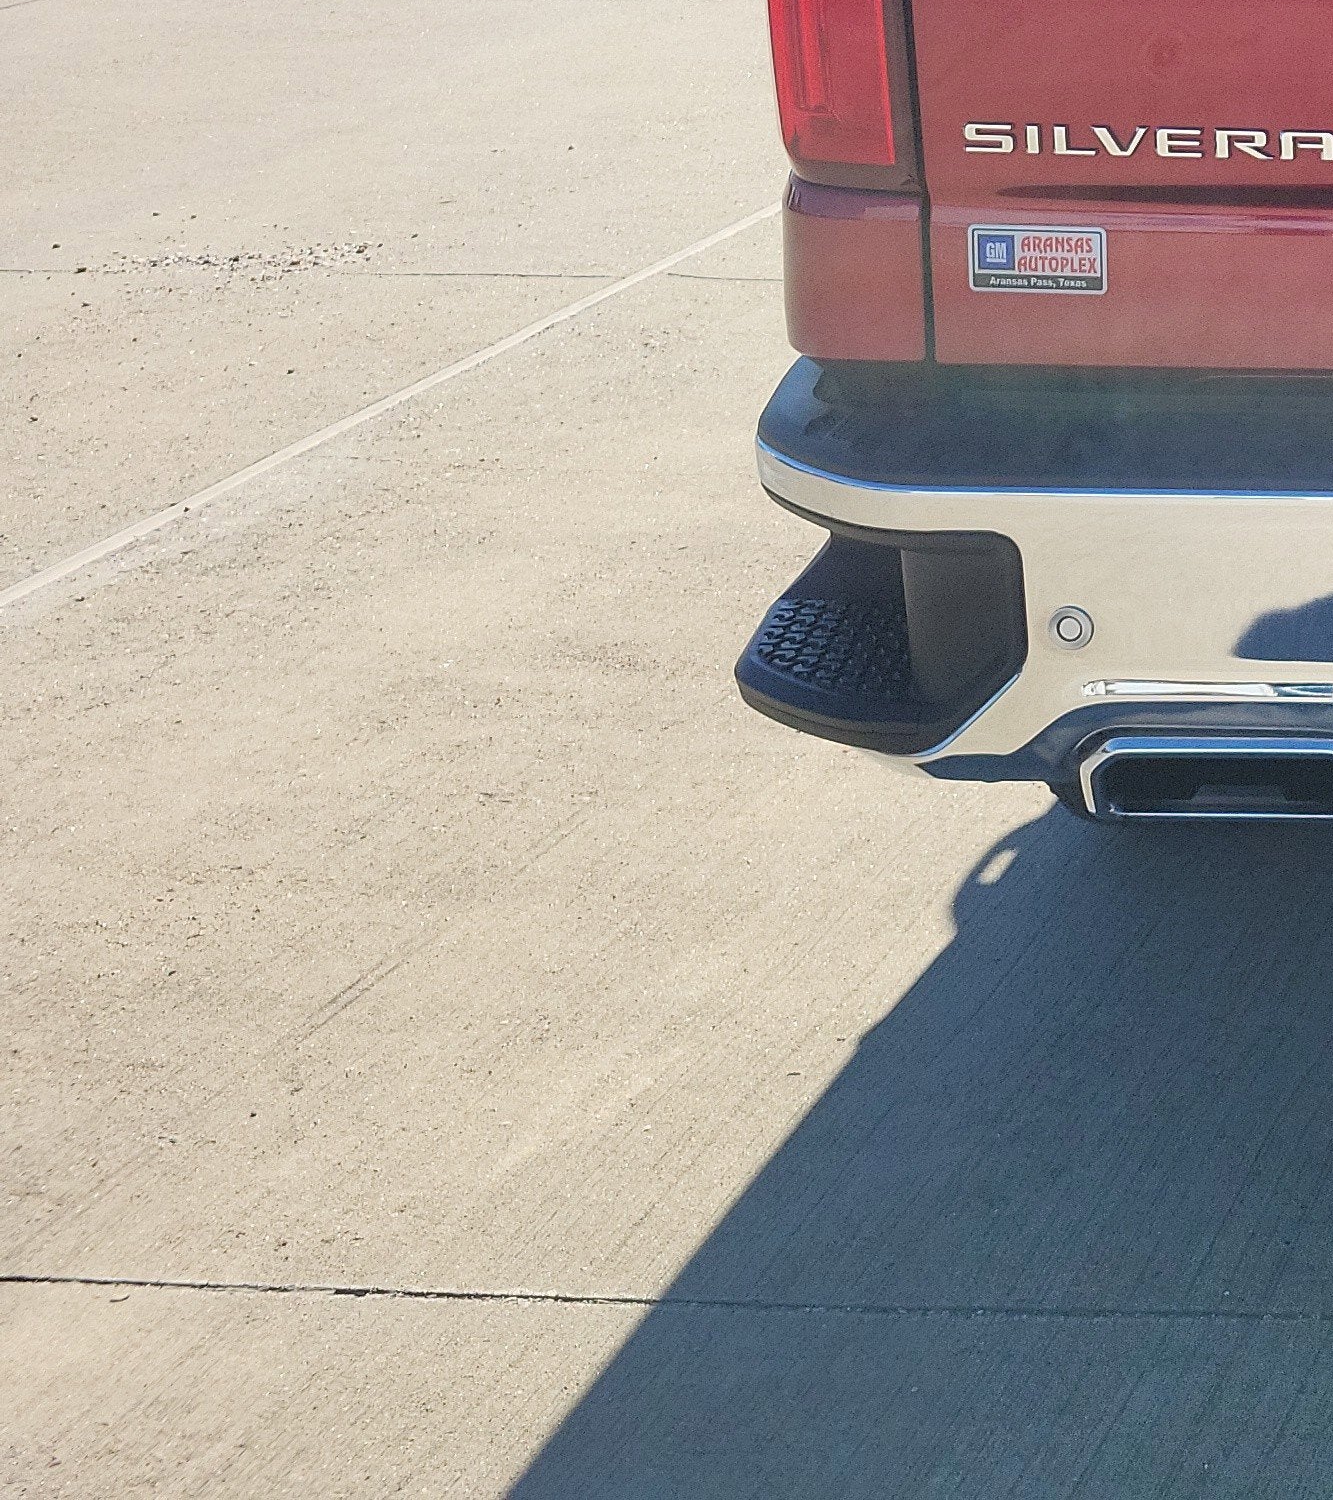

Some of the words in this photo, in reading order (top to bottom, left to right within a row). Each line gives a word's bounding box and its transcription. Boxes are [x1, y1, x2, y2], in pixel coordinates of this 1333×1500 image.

[986, 241, 1008, 261] GM
[1020, 235, 1094, 255] ARANSAS
[1017, 255, 1098, 274] AUTOPLEX
[989, 276, 1028, 287] Aransas
[1030, 277, 1056, 288] Pass,
[1058, 278, 1088, 288] Texas
